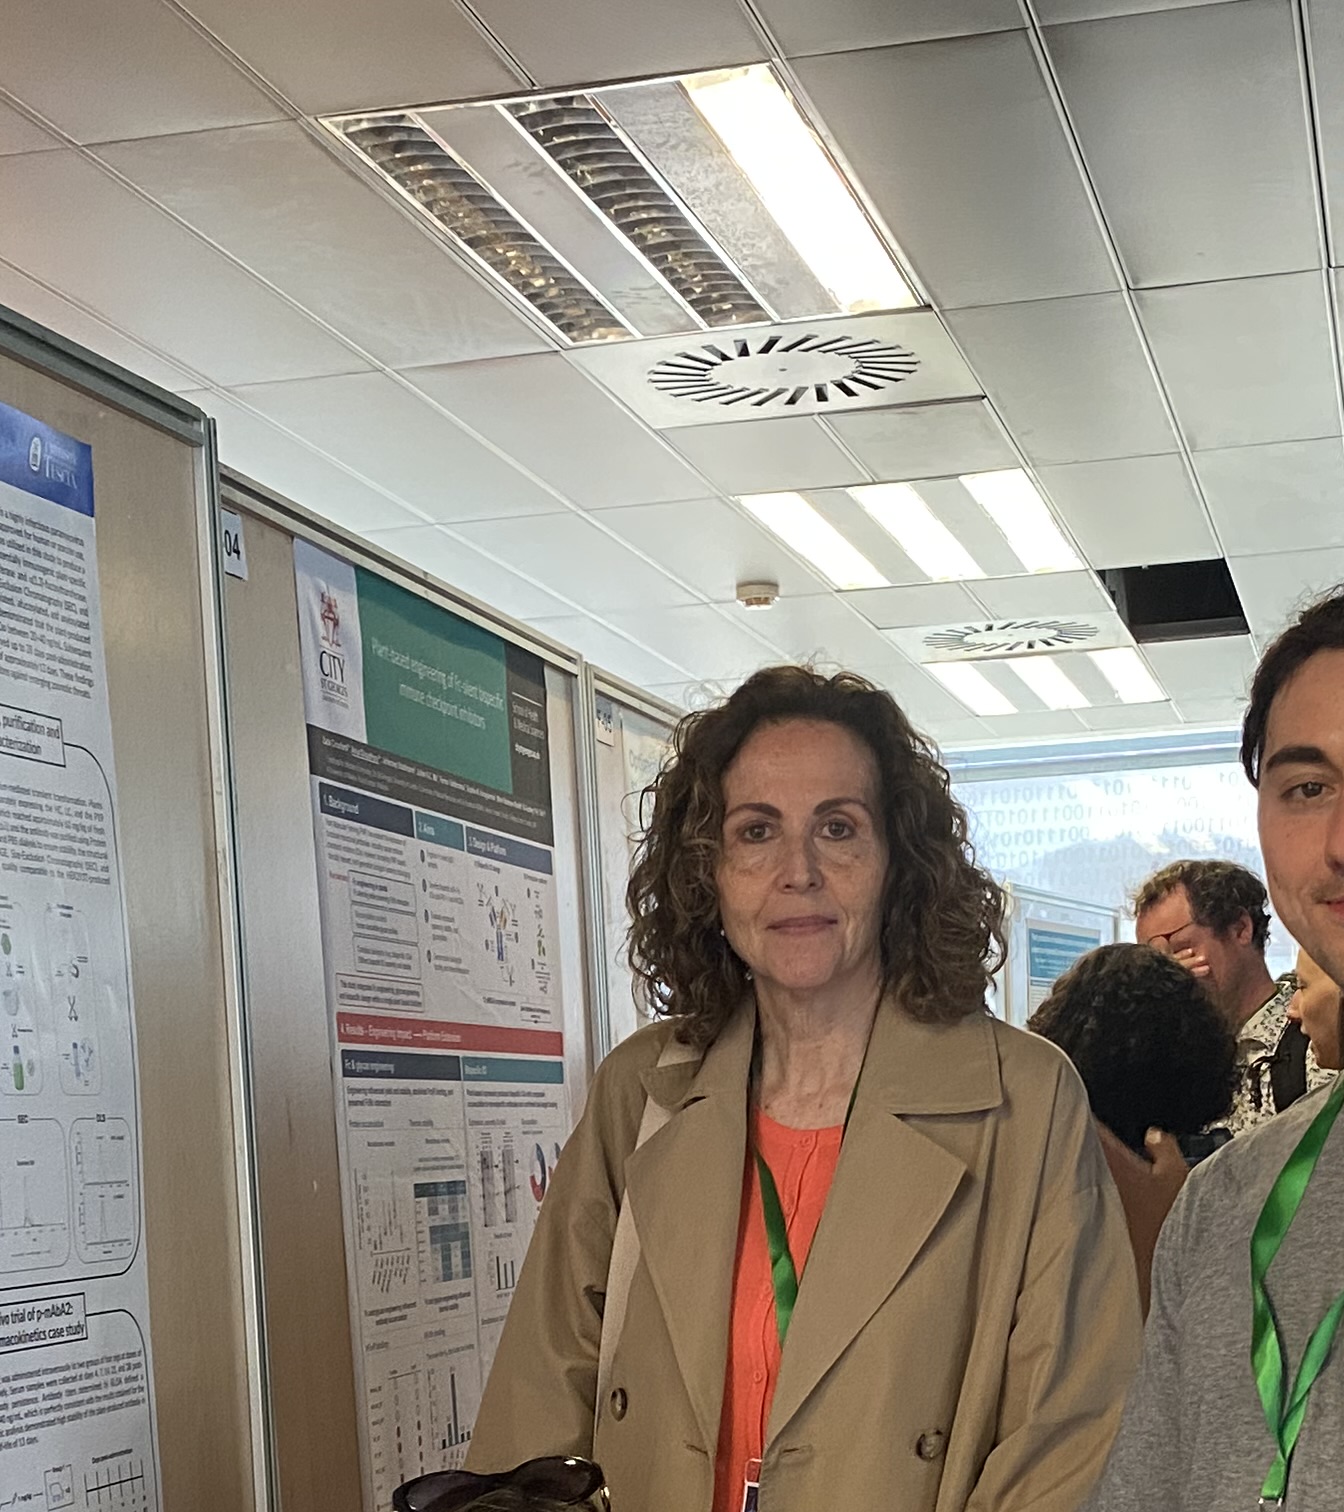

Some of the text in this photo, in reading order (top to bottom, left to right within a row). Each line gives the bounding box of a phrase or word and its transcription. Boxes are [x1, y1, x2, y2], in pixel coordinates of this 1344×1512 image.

[224, 529, 241, 561] 04
[319, 650, 346, 683] CITY
[2, 715, 46, 736] purification
[46, 725, 61, 740] and
[10, 1308, 26, 1325] trial
[26, 1306, 36, 1322] of
[36, 1301, 74, 1323] p-mAbA2:
[47, 1327, 65, 1340] case
[65, 1320, 85, 1337] study
